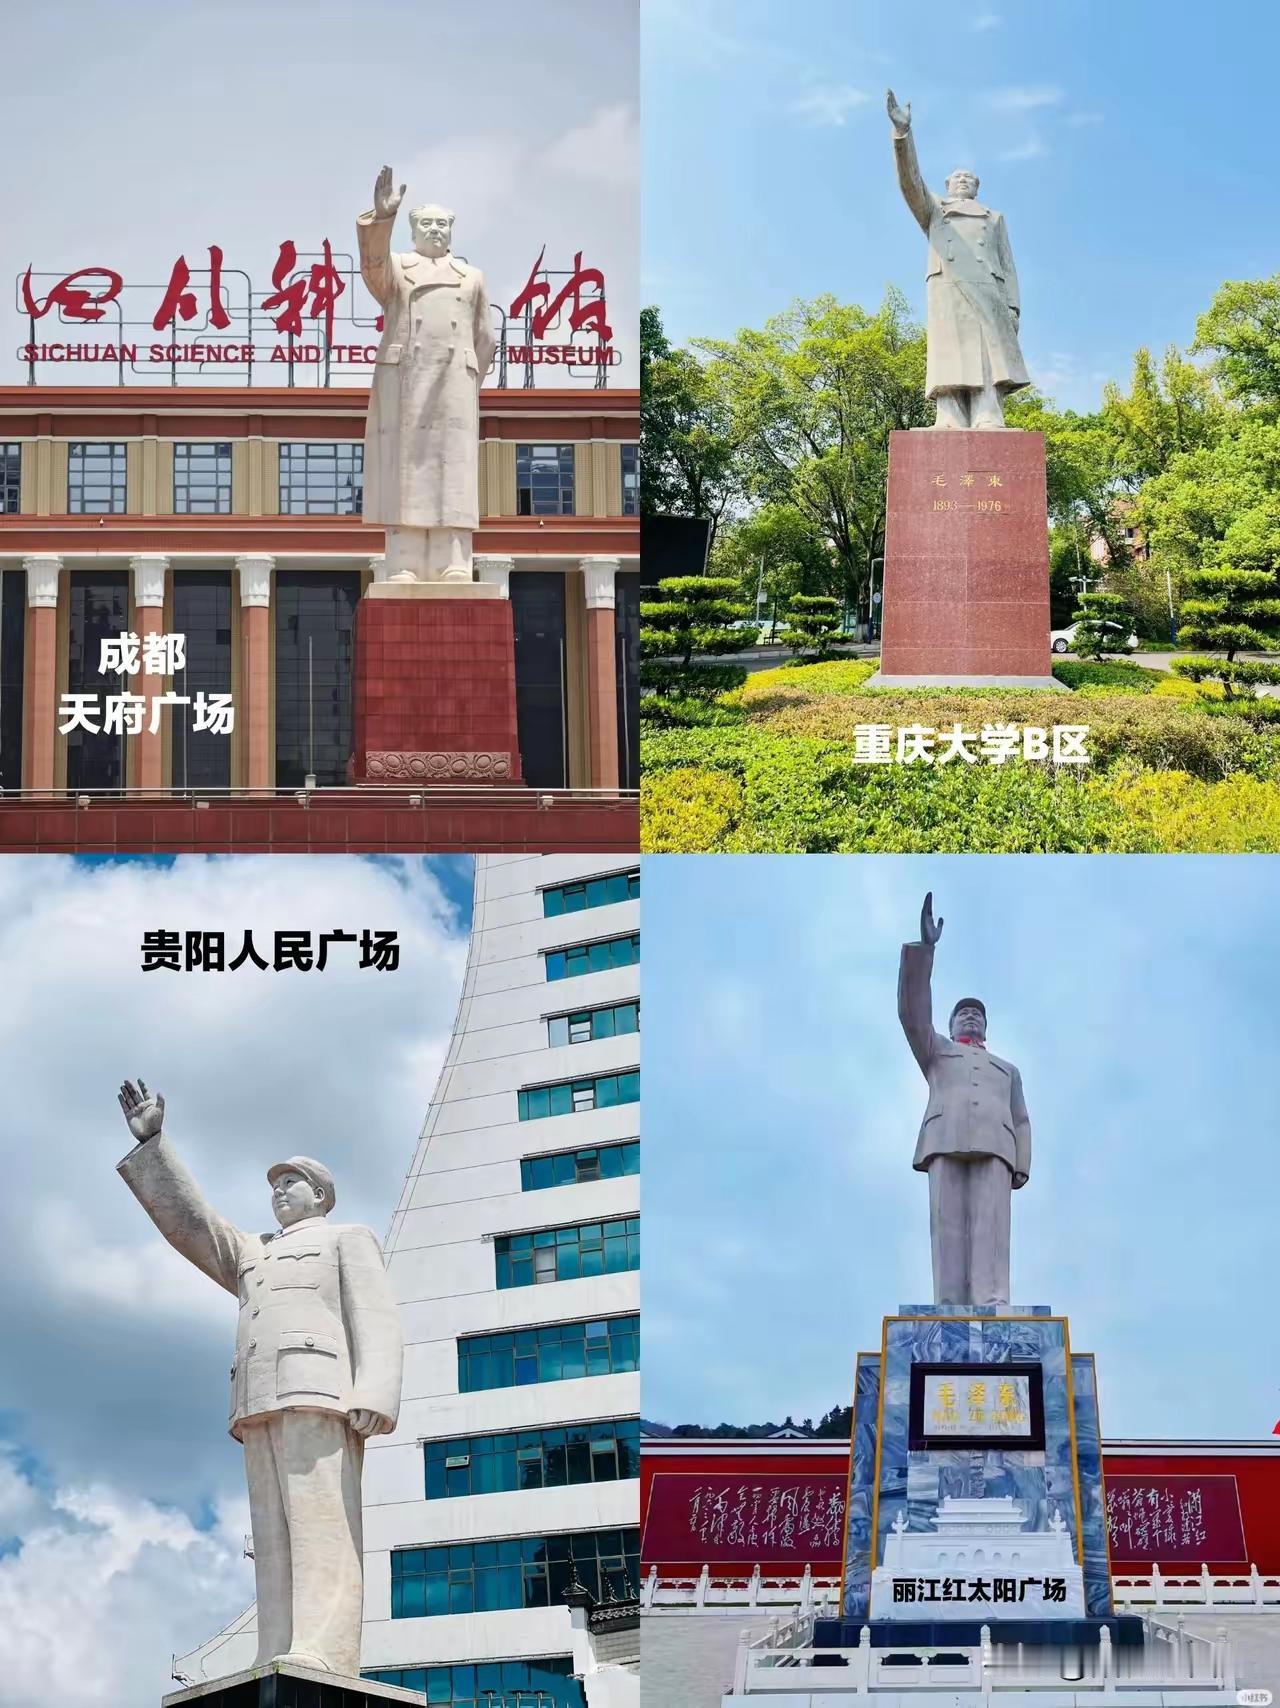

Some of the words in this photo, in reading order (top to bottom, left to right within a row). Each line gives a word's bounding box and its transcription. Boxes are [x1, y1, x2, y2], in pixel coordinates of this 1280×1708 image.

[23, 344, 137, 363] SICHUAN
[149, 344, 256, 363] SCIENCE
[270, 345, 321, 363] AND
[508, 345, 614, 365] MUSEUM
